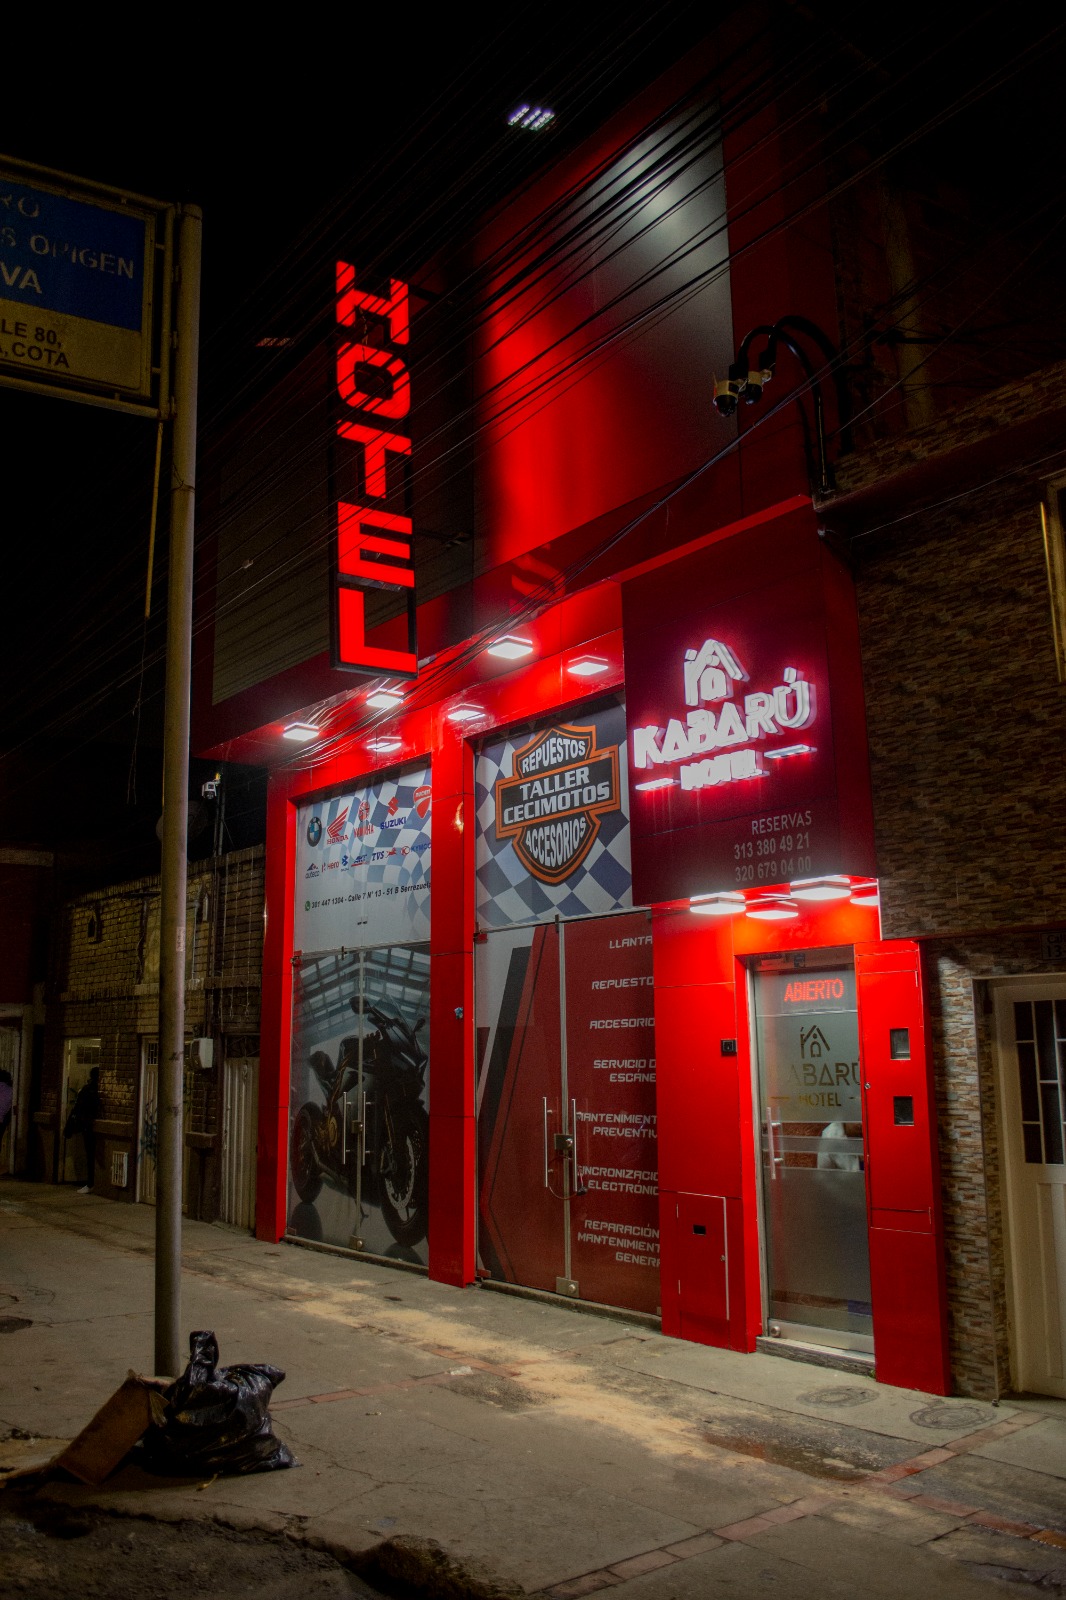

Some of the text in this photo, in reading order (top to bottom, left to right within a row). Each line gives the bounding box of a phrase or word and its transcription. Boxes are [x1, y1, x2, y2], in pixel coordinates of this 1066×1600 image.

[1, 318, 62, 349] LE 80,
[336, 260, 417, 673] HOTEL
[633, 666, 816, 769] KABARÚ
[521, 736, 586, 775] REPUESTOS
[679, 748, 764, 791] HOTEL
[519, 766, 590, 801] TALLER
[503, 780, 610, 825] CECIMOTOS
[380, 816, 407, 830] SUZUKI
[751, 810, 812, 836] RESERVAS
[326, 834, 349, 845] HONDA
[525, 816, 587, 867] ACCESORIOS
[734, 831, 810, 861] 313 380 49 21
[734, 854, 812, 883] 320 679 04 00
[348, 894, 362, 902] Calle
[375, 889, 382, 897] 13
[591, 975, 654, 990] REPUESTO
[783, 978, 845, 1003] ABIERTO
[593, 1058, 647, 1069] SERVICIO
[799, 1090, 842, 1107] HOTEL
[584, 1219, 660, 1238] REPARACIÓN
